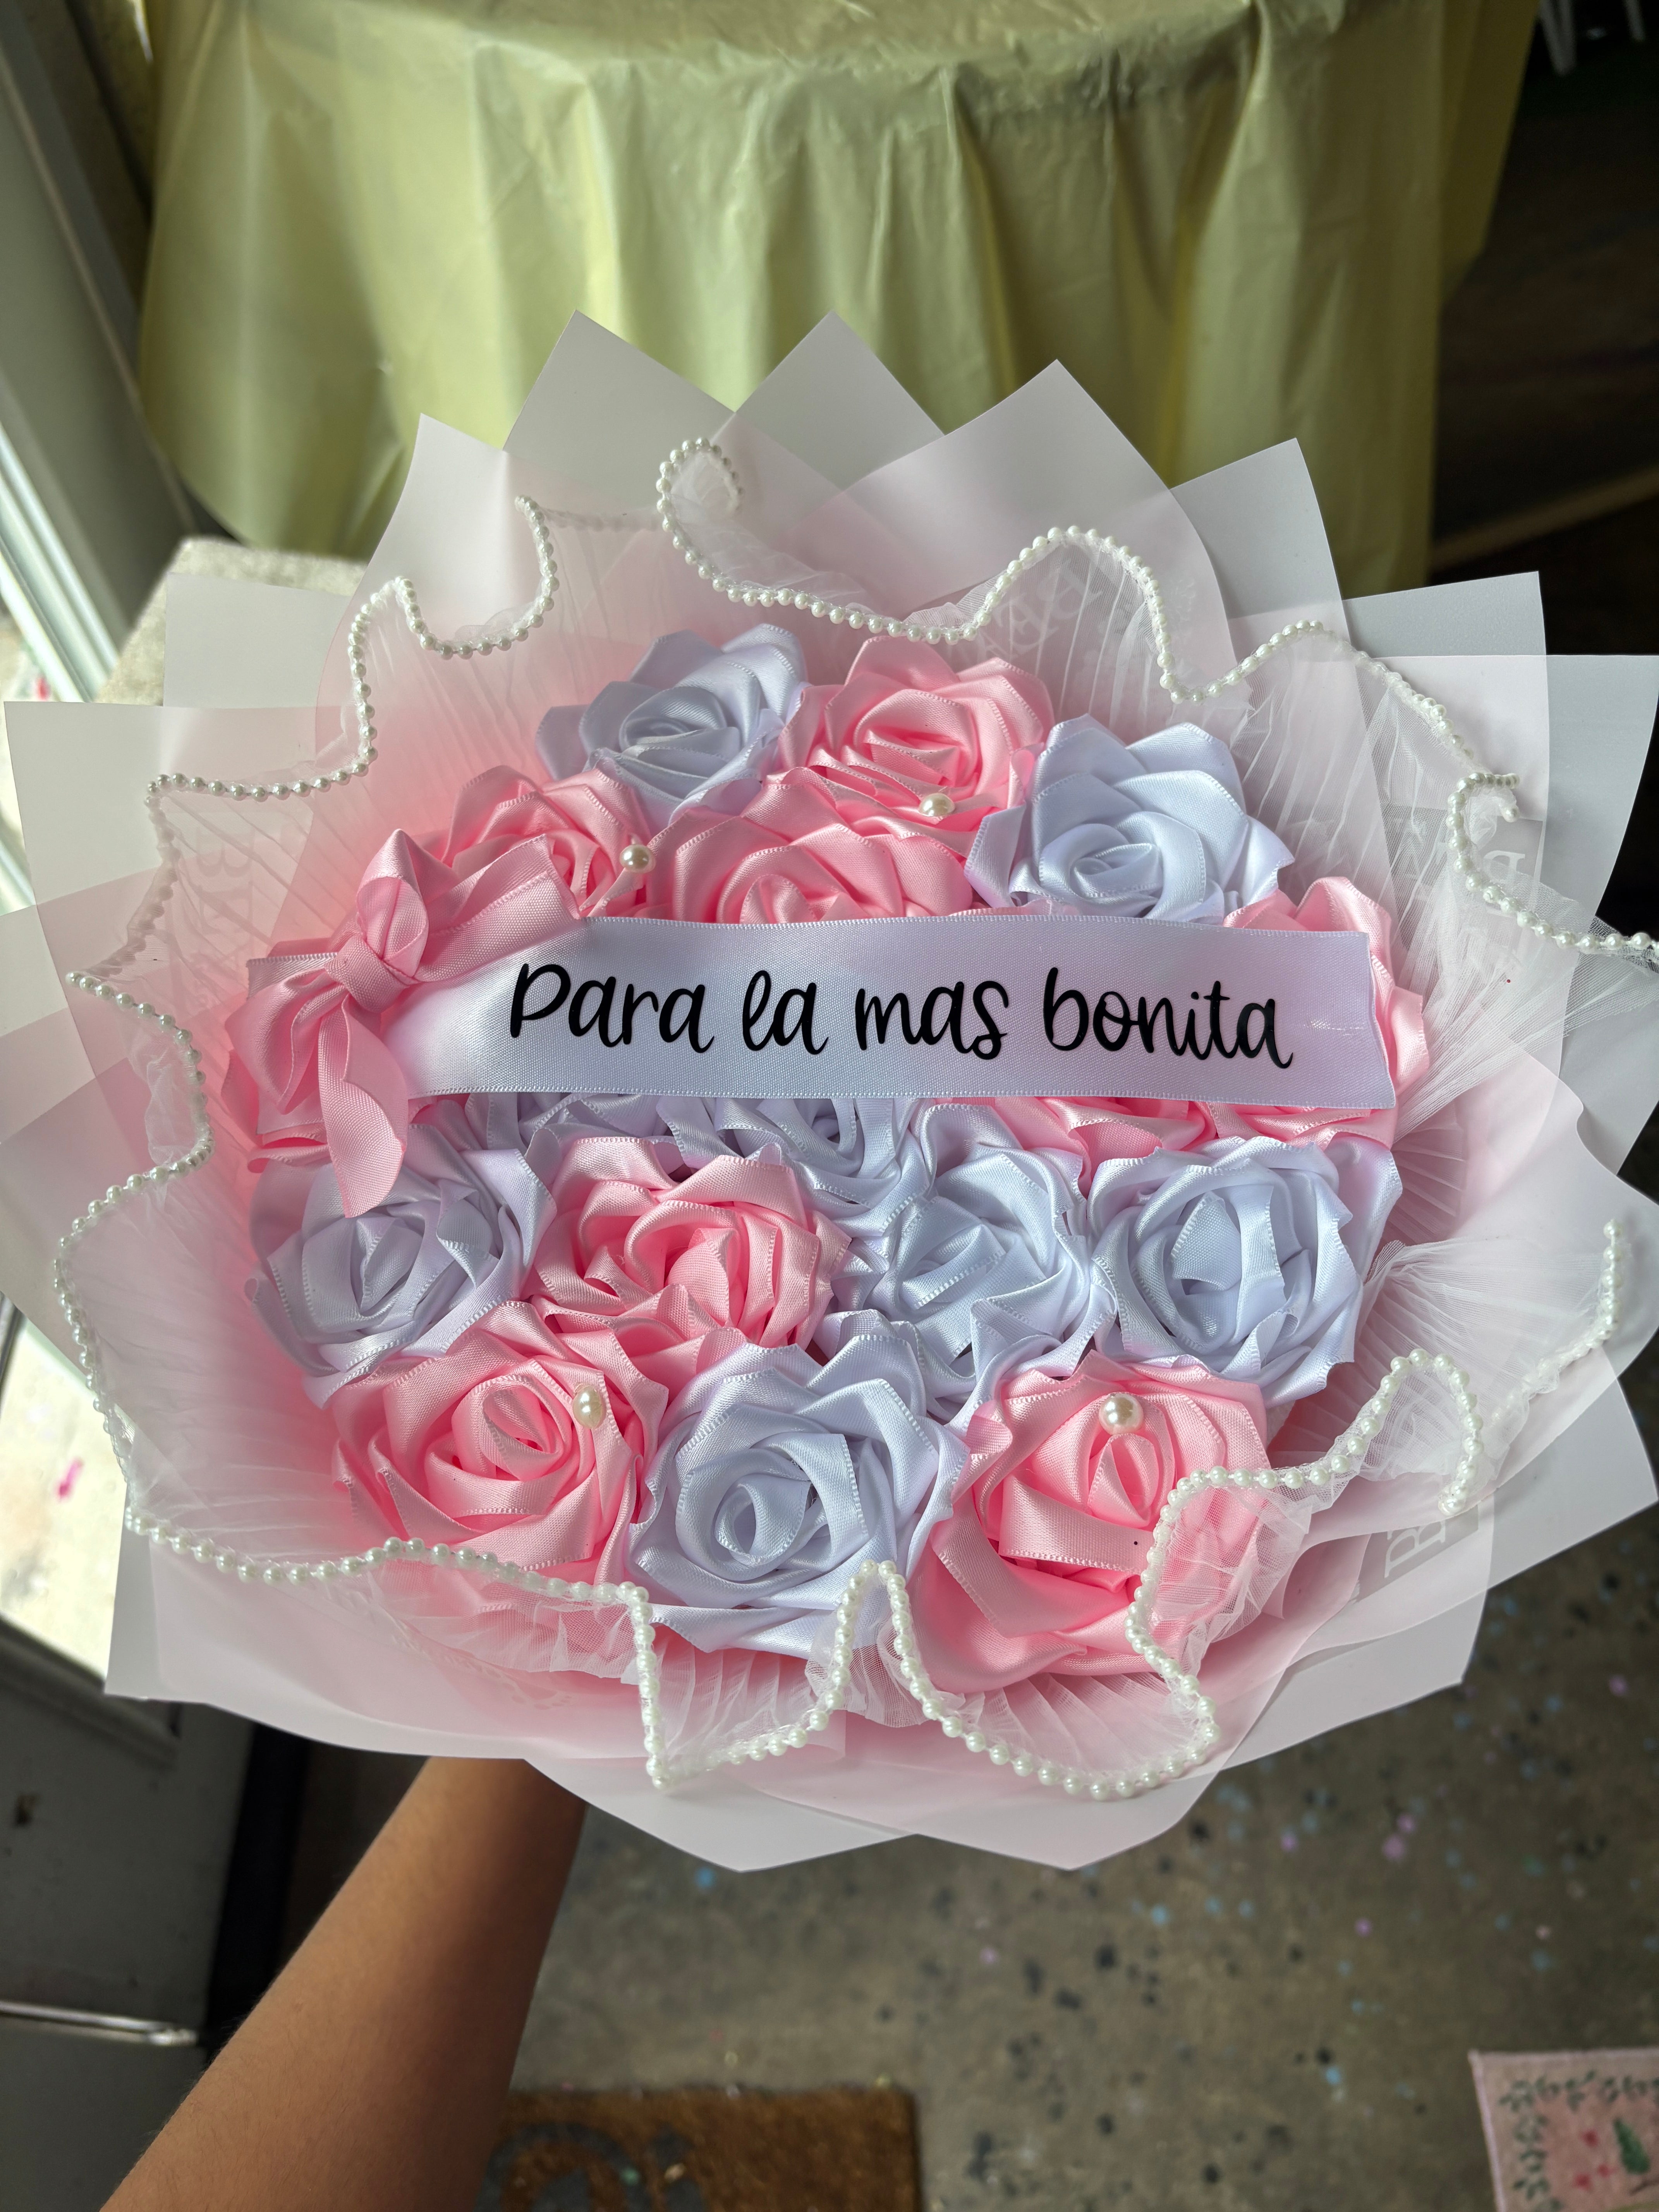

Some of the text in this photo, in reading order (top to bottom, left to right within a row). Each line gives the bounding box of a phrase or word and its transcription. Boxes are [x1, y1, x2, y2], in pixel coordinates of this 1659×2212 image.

[509, 963, 1294, 1070] Para la mas bonita
